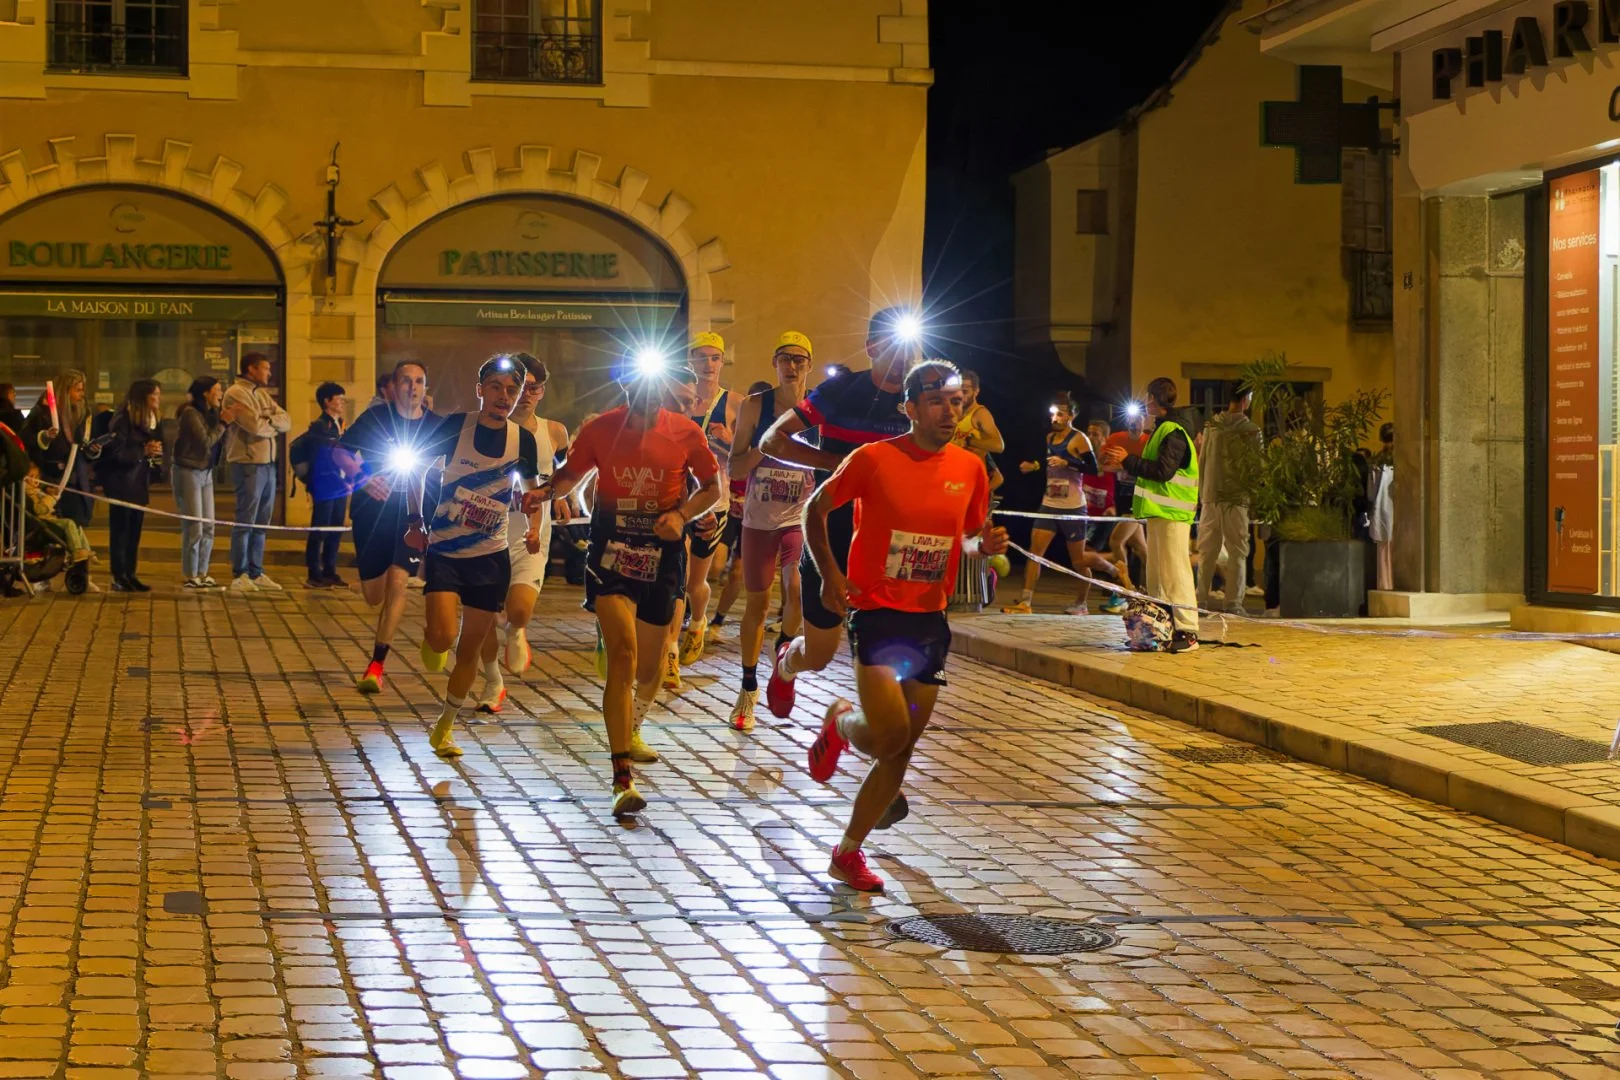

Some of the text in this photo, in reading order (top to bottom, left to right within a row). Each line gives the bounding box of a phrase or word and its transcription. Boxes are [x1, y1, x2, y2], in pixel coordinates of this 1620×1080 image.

[1552, 232, 1597, 252] Nos services
[8, 240, 232, 271] BOULANGERIE
[439, 249, 619, 278] PATISSERIE
[48, 300, 194, 314] LA MAISON DU PAIN
[476, 308, 509, 319] Artisan
[510, 309, 555, 321] Boulanger
